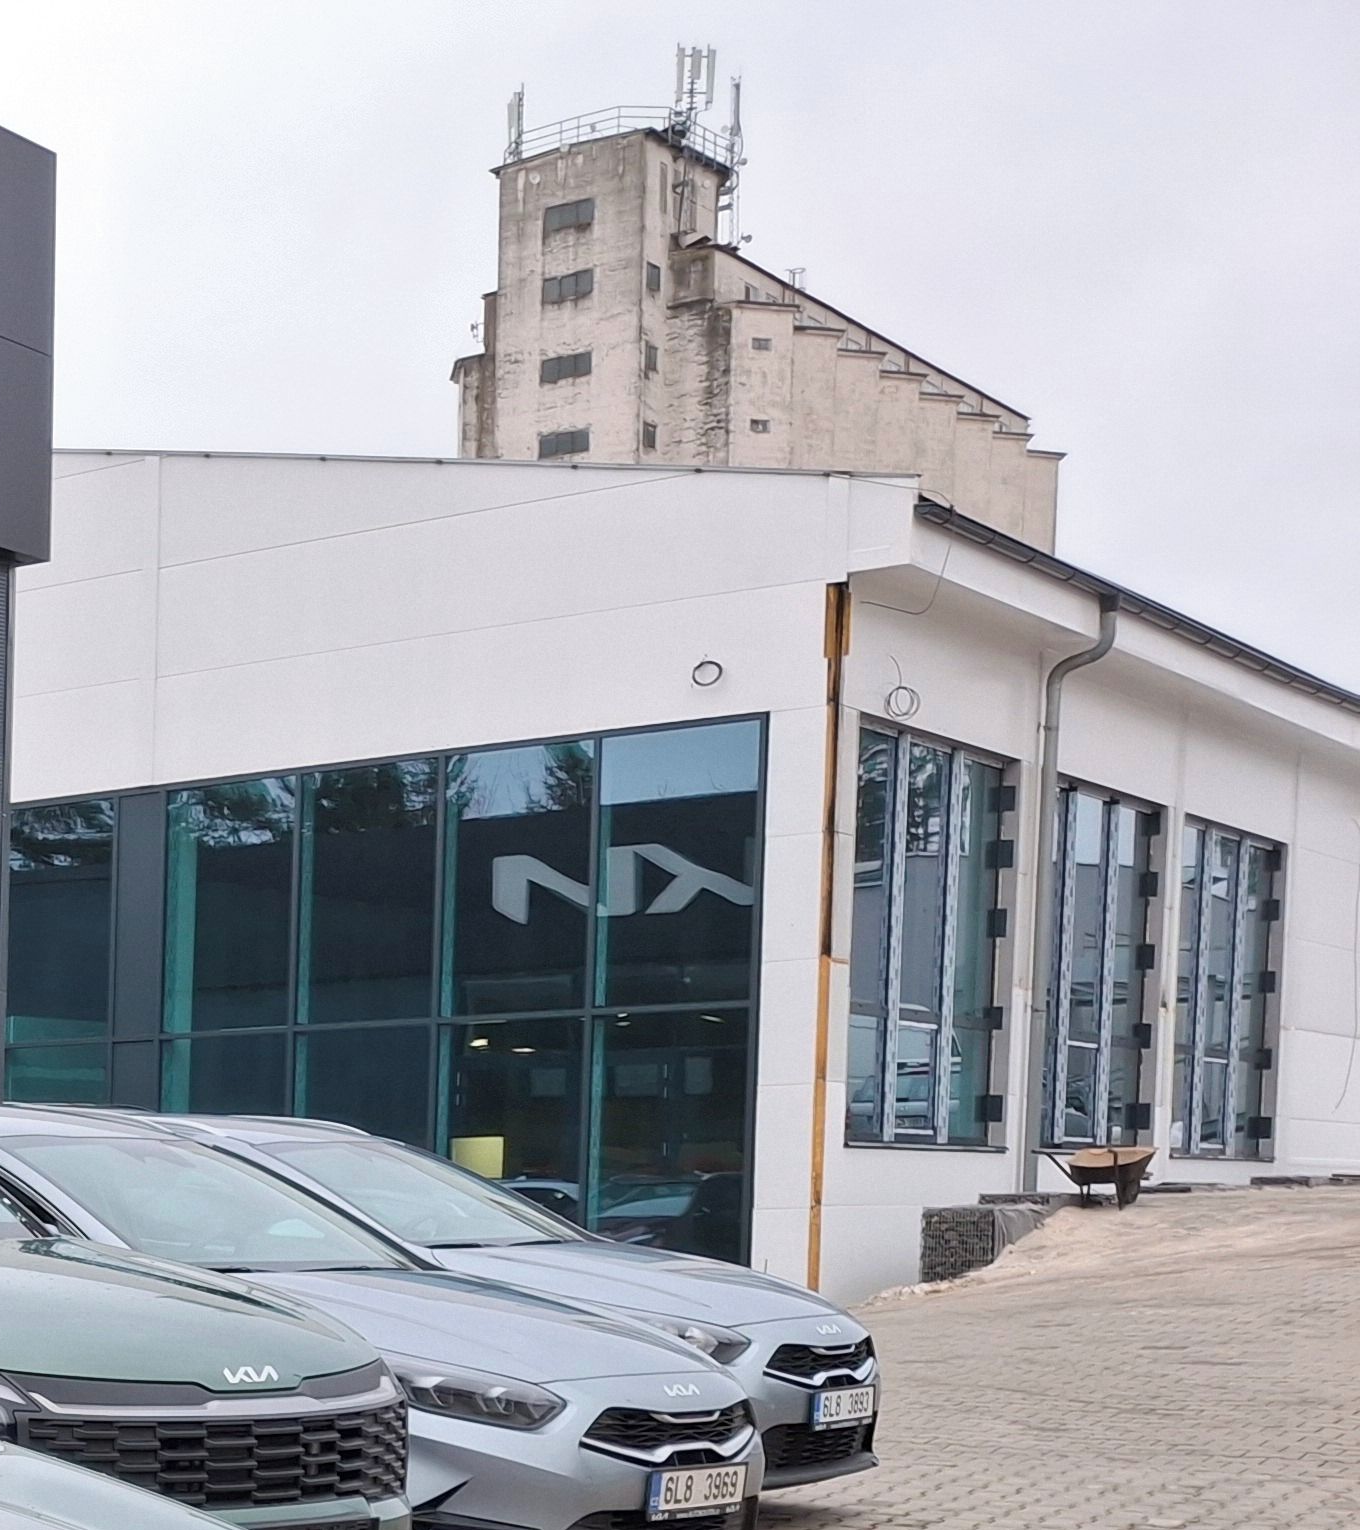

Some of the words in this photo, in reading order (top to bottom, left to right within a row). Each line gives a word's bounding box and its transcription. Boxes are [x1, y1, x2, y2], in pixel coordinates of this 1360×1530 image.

[223, 1365, 279, 1384] KIA
[663, 1383, 700, 1397] KIA
[823, 1395, 842, 1418] 6L8
[664, 1474, 694, 1505] 6L8
[704, 1470, 738, 1501] 3969
